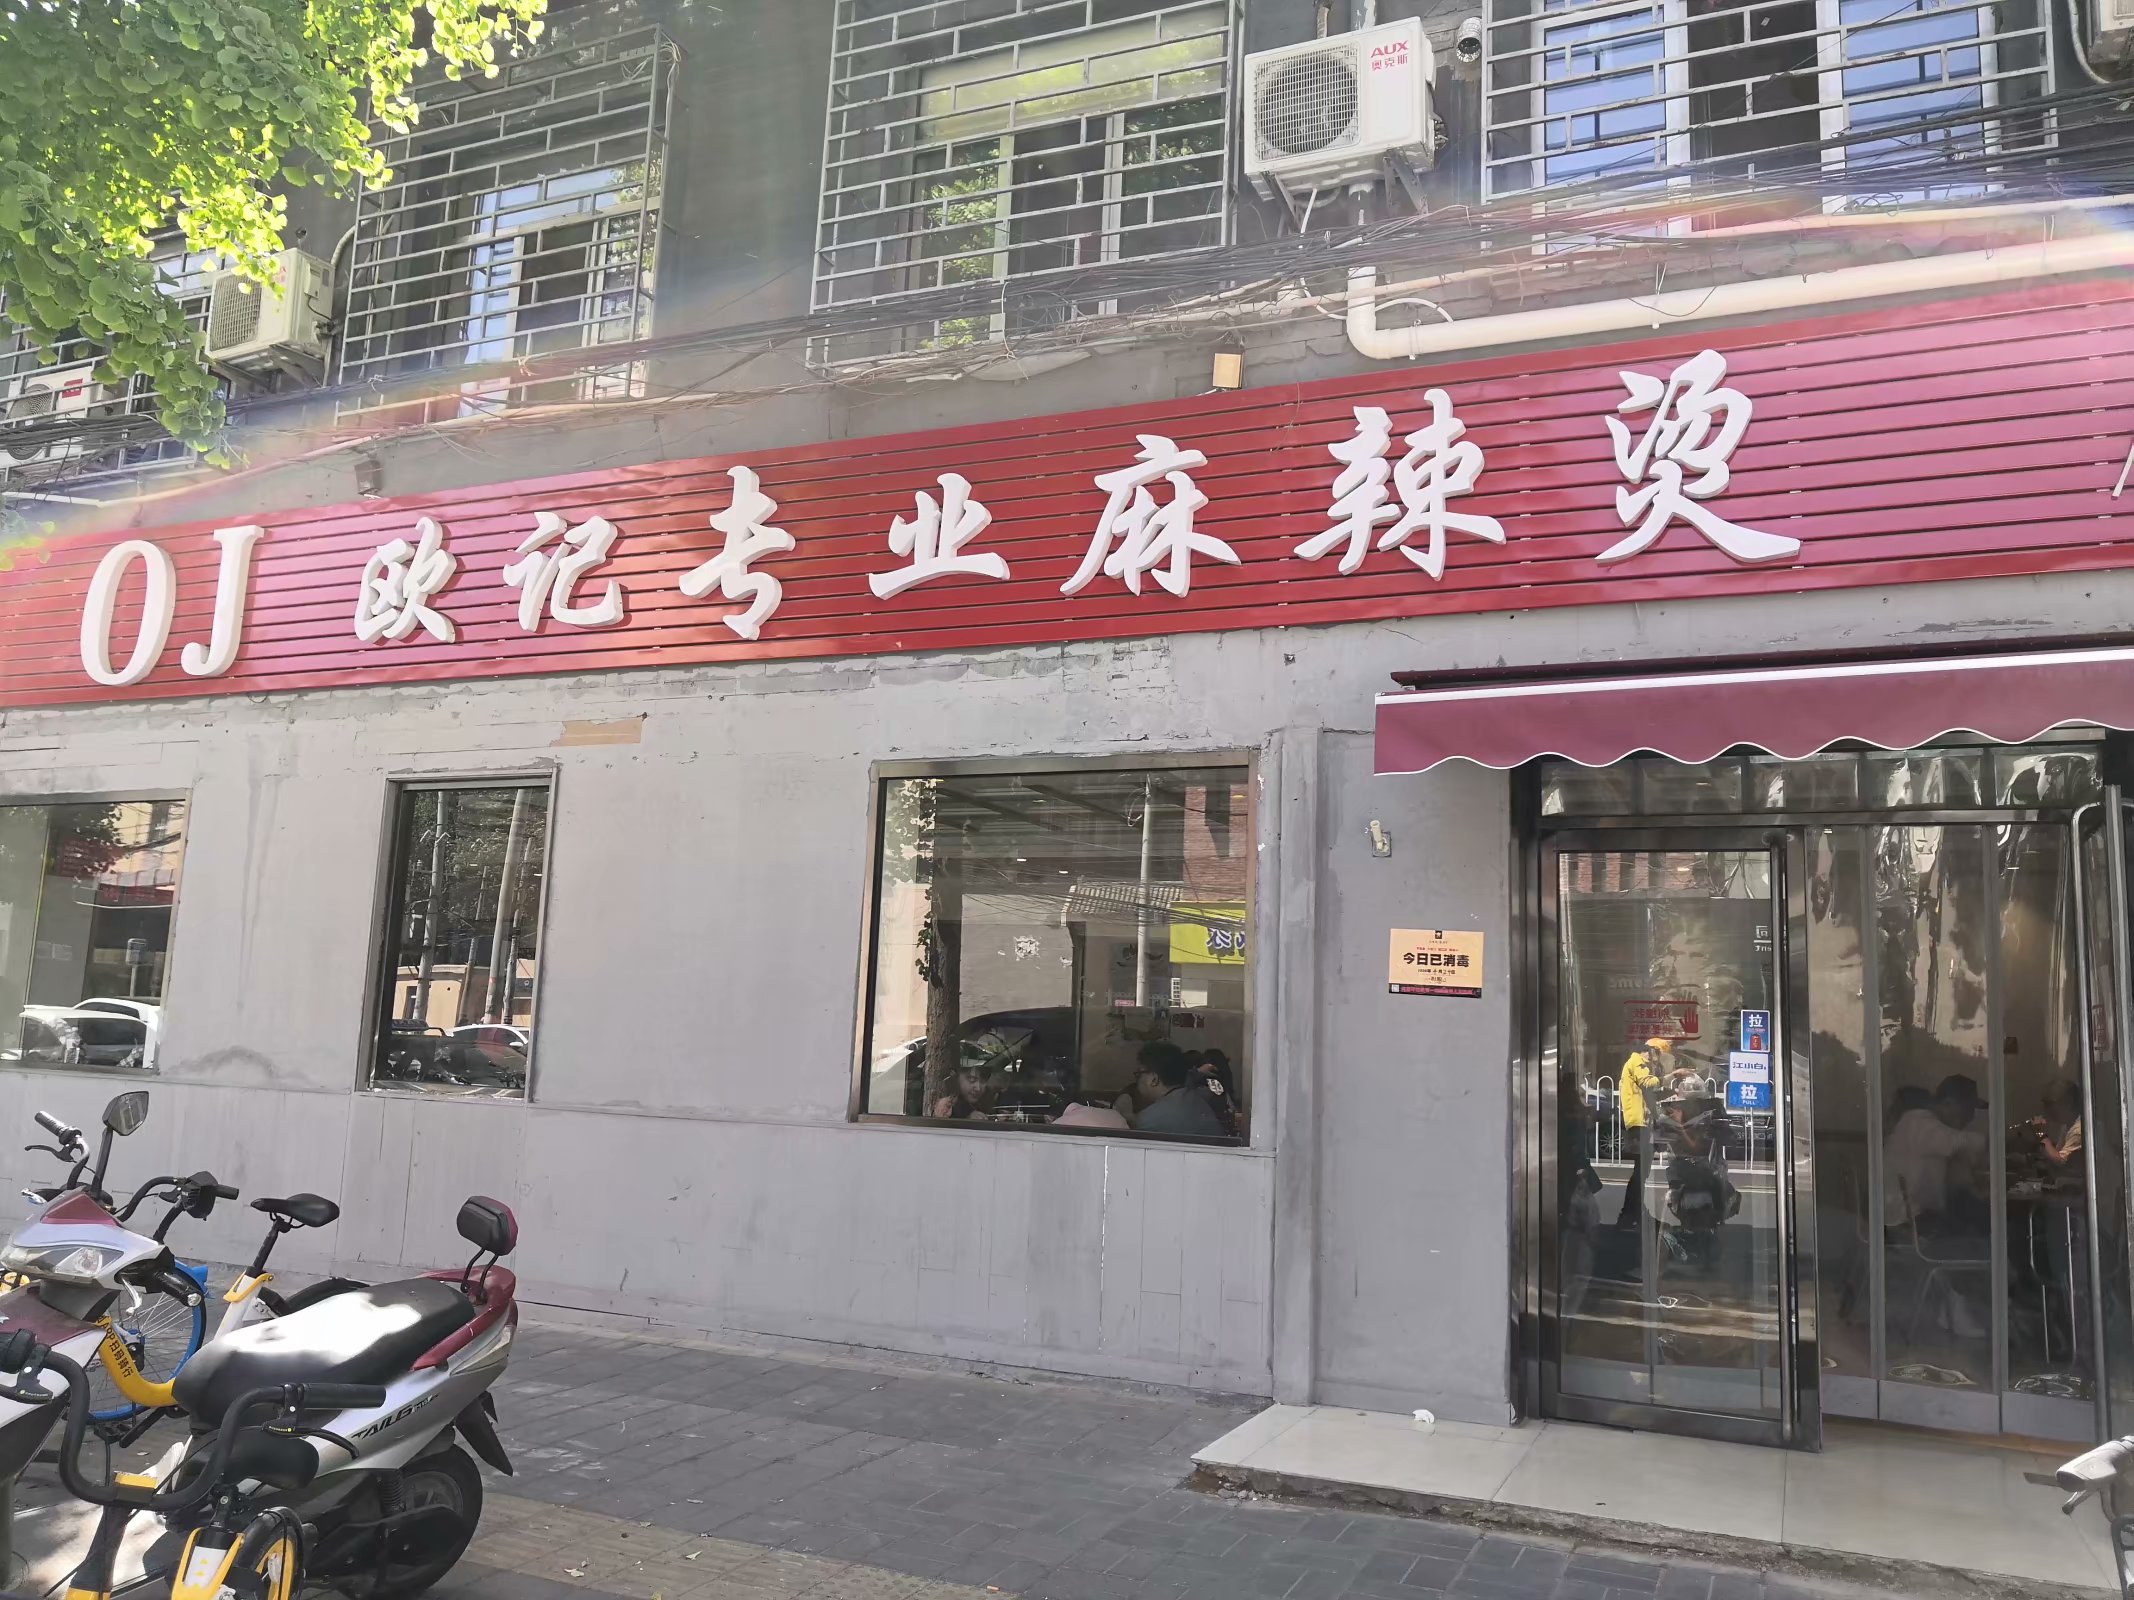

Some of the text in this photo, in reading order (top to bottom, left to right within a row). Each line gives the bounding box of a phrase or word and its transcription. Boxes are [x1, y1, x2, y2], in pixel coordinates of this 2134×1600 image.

[1370, 40, 1409, 58] AUX
[1371, 54, 1408, 71] 奥克斯
[80, 349, 1801, 687] OJ 欧记专业麻辣烫
[1403, 952, 1470, 968] 今日已消毒
[1748, 1013, 1764, 1028] 拉
[1732, 1061, 1764, 1071] 江小白
[1740, 1083, 1758, 1100] 拉
[351, 1404, 414, 1440] TAILG
